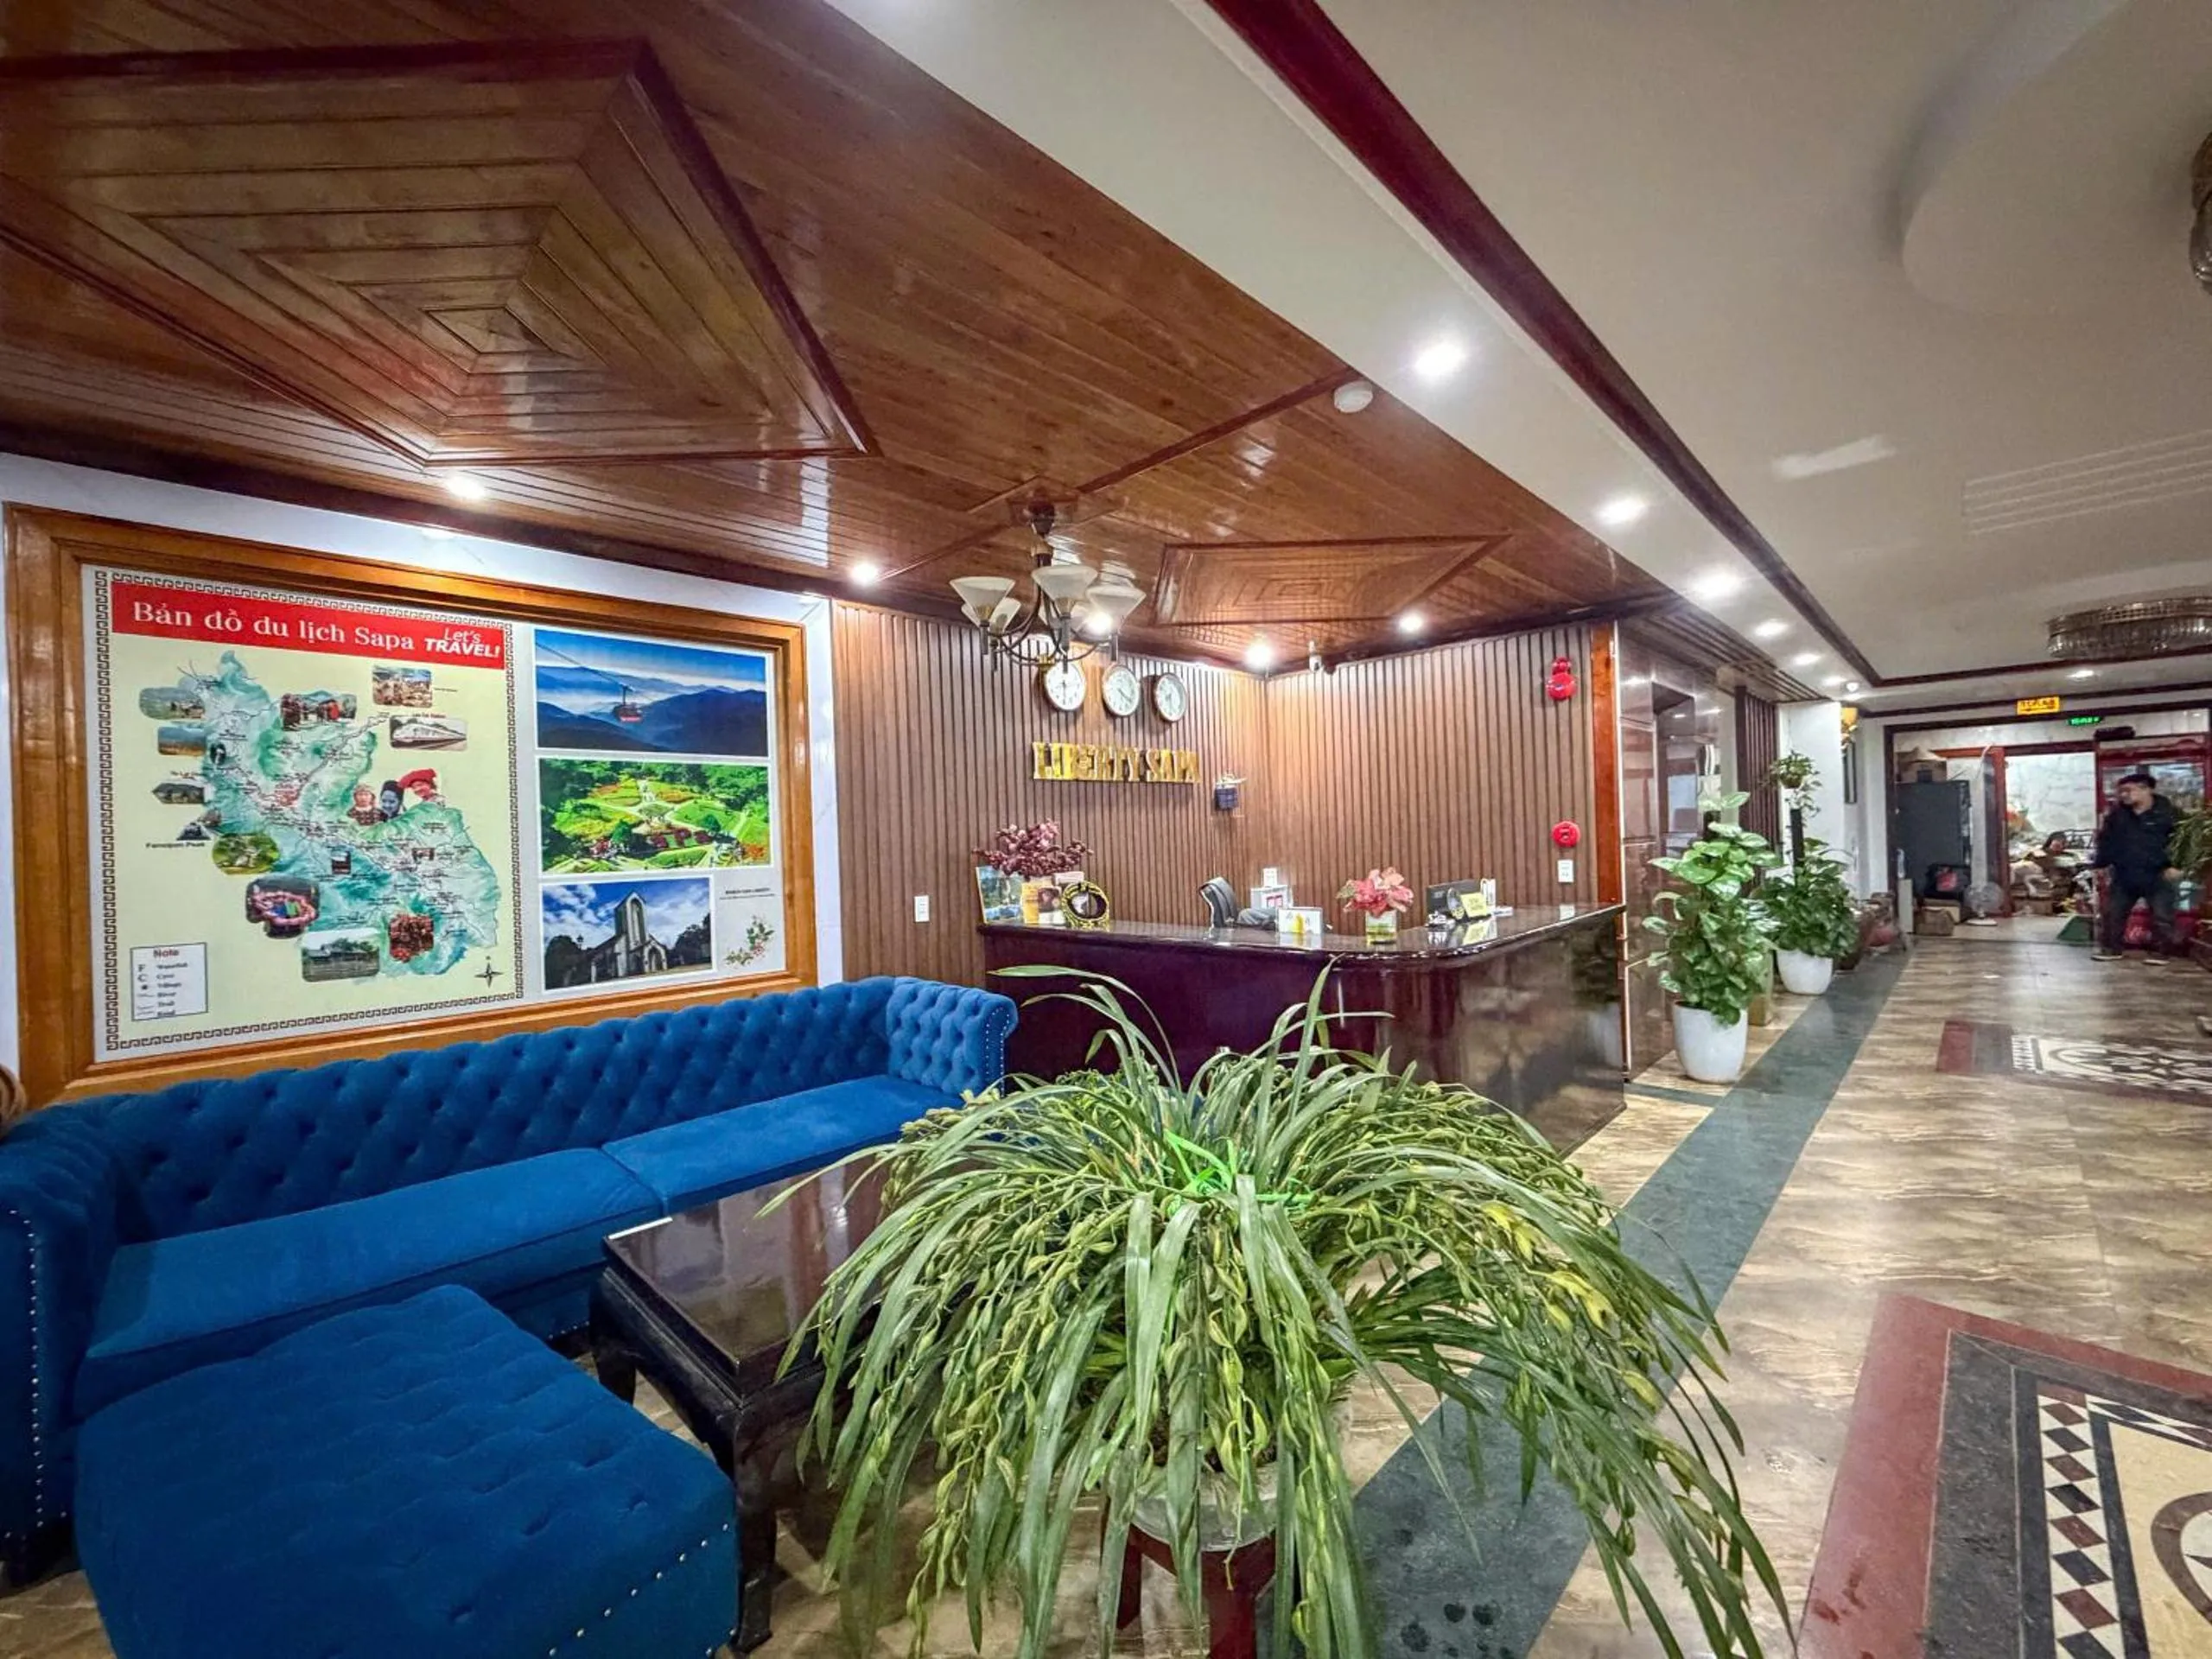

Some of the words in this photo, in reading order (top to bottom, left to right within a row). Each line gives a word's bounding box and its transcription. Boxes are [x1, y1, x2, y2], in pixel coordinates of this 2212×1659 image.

[253, 615, 289, 638] du
[298, 620, 346, 644] lịch
[354, 626, 416, 651] Sapa
[443, 627, 482, 644] Let's
[423, 638, 501, 658] TRAVEL!
[1033, 741, 1141, 782] LIBERTY
[1146, 747, 1202, 784] SAPA
